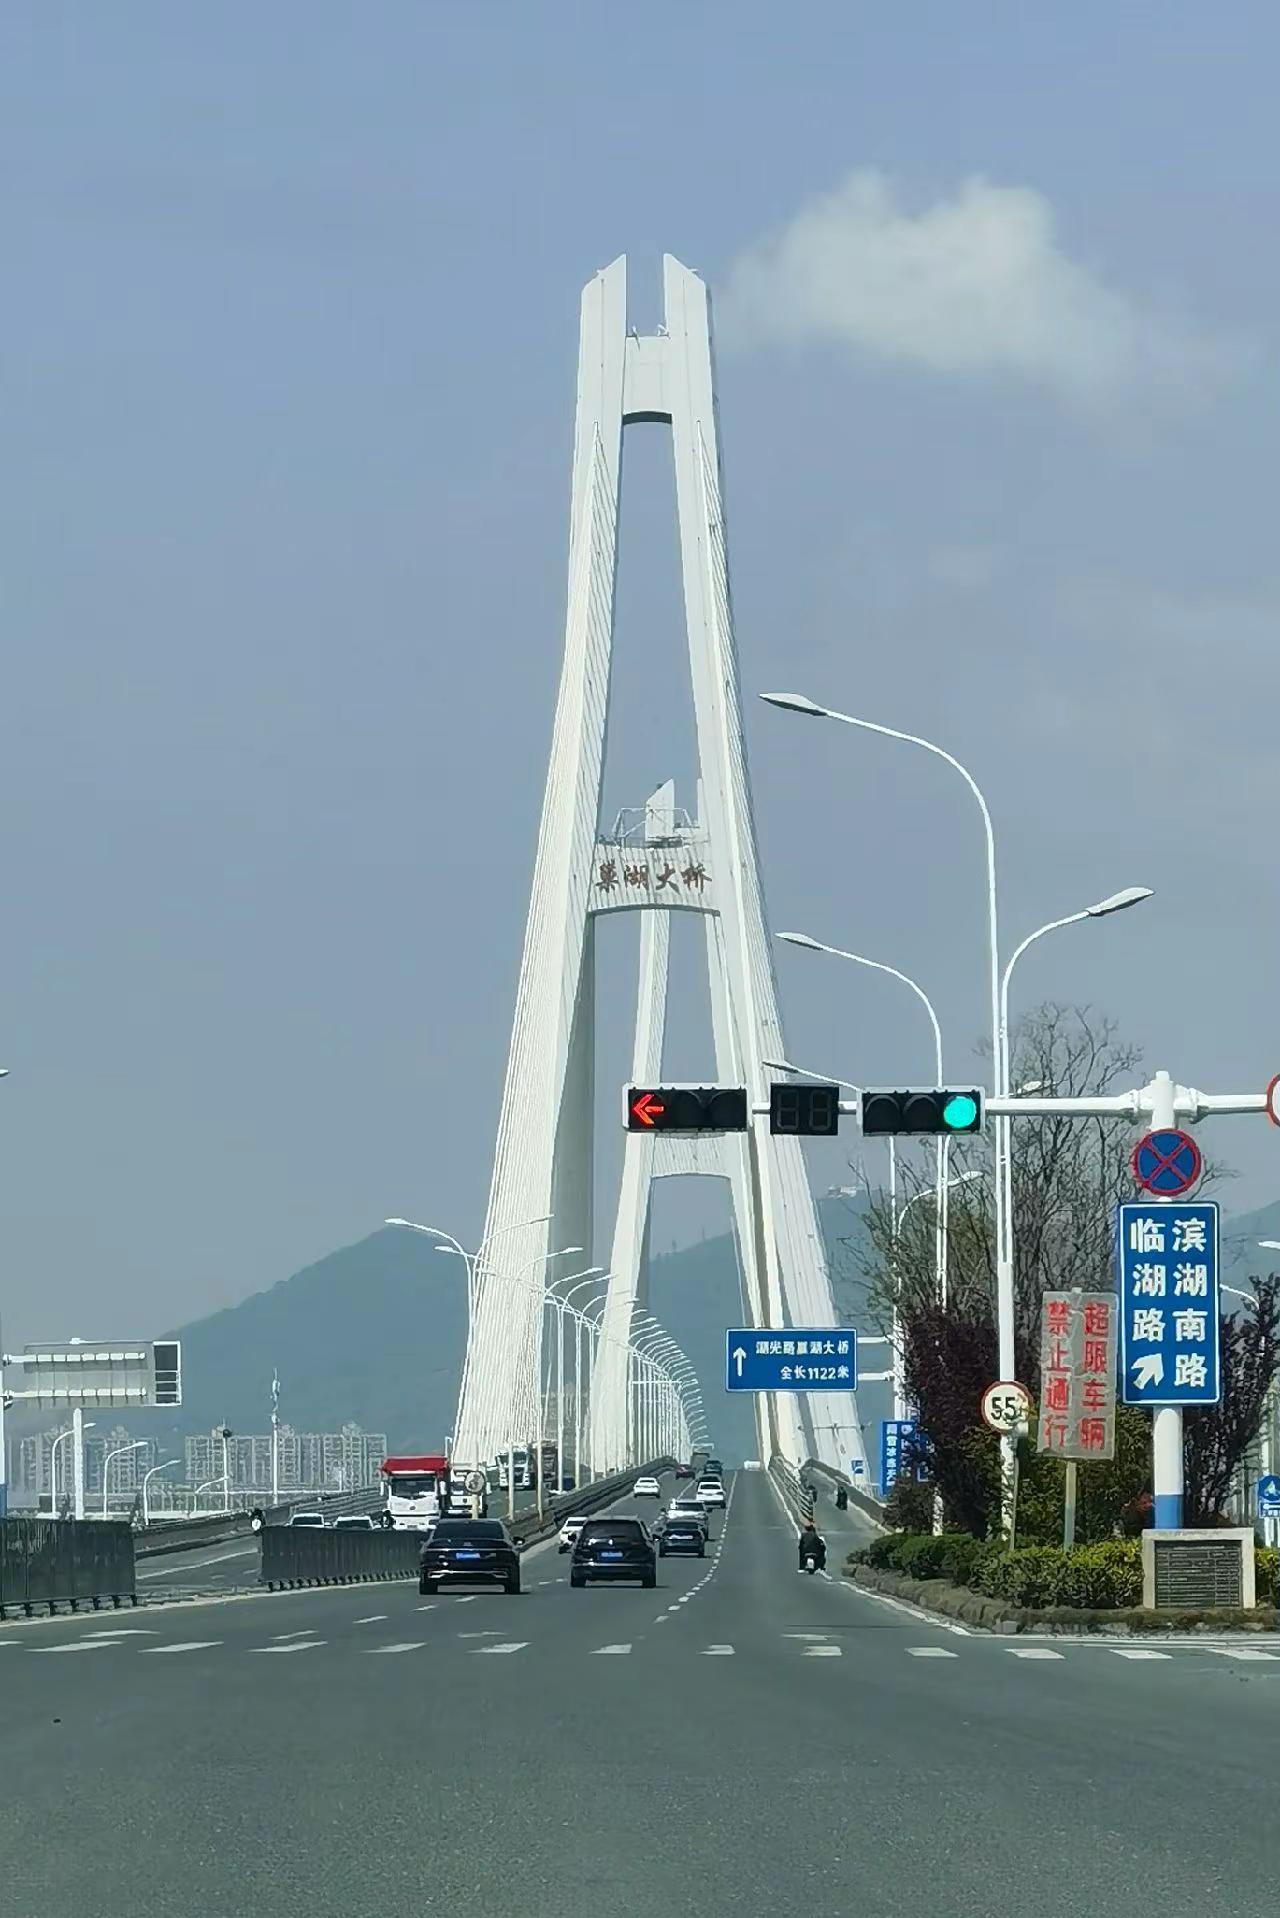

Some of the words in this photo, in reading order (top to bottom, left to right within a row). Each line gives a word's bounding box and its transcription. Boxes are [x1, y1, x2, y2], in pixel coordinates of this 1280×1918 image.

[1130, 1218, 1166, 1342] 临湖路
[1172, 1217, 1208, 1387] 滨湖南路
[780, 1365, 849, 1380] 全长1122米
[991, 1396, 1017, 1420] 55
[1044, 1300, 1071, 1447] 禁止通行
[1078, 1302, 1109, 1450] 超限车辆
